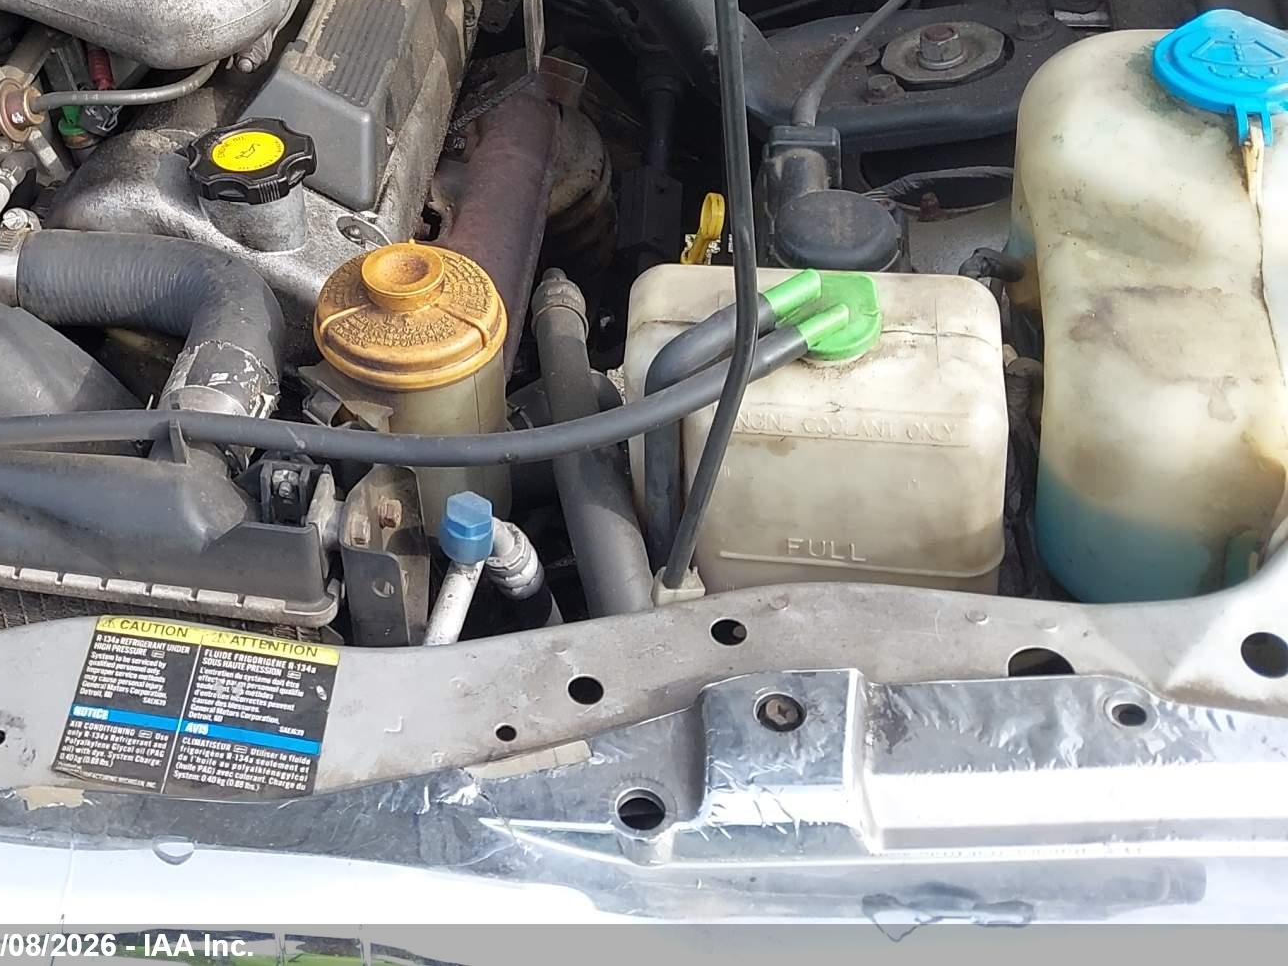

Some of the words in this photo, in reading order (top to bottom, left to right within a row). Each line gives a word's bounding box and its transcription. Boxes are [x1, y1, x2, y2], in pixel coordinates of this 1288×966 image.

[733, 411, 793, 433] NGINE
[786, 537, 867, 561] FULL
[119, 619, 189, 637] CAUTION
[231, 634, 318, 657] ATTENTION
[120, 637, 167, 651] REFRIGERANT
[166, 644, 191, 654] UNDER
[94, 642, 111, 652] HIGH
[111, 644, 148, 656] PRESSURE
[204, 649, 232, 660] FLUIDE
[88, 659, 116, 669] qualified
[115, 662, 147, 674] personnel
[91, 651, 115, 663] System
[131, 656, 158, 668] serviced
[158, 660, 167, 670] by
[202, 657, 222, 667] SOUS
[222, 660, 246, 671] HAUTE
[246, 663, 282, 677] PRESSION
[83, 673, 98, 683] may
[98, 676, 117, 685] cause
[117, 678, 145, 689] personal
[115, 670, 138, 679] service
[138, 673, 167, 684] methods
[81, 680, 107, 691] General
[107, 684, 129, 695] Motors
[247, 682, 279, 695] personnel
[190, 703, 216, 714] General
[216, 706, 240, 717] Motors
[192, 697, 214, 706] causer
[215, 699, 227, 708] des
[267, 701, 295, 712] peuvent
[73, 705, 109, 720] NOTICE
[69, 720, 83, 728] AIR
[83, 722, 136, 737] CONDITIONING
[154, 733, 169, 741] Use
[64, 736, 110, 750] Polyalkylene
[111, 742, 135, 754] Glycol
[135, 746, 146, 755] oil
[67, 729, 82, 739] only
[110, 734, 152, 747] Refrigerant
[153, 741, 167, 749] and
[75, 746, 91, 755] with
[107, 751, 134, 763] System
[182, 737, 231, 751] CLIMATISEUR
[288, 753, 311, 764] fluide
[255, 757, 299, 771] seulement
[299, 765, 310, 773] et
[197, 764, 216, 775] PAG)
[216, 769, 233, 777] avec
[267, 776, 295, 790] Charge
[296, 783, 307, 791] du
